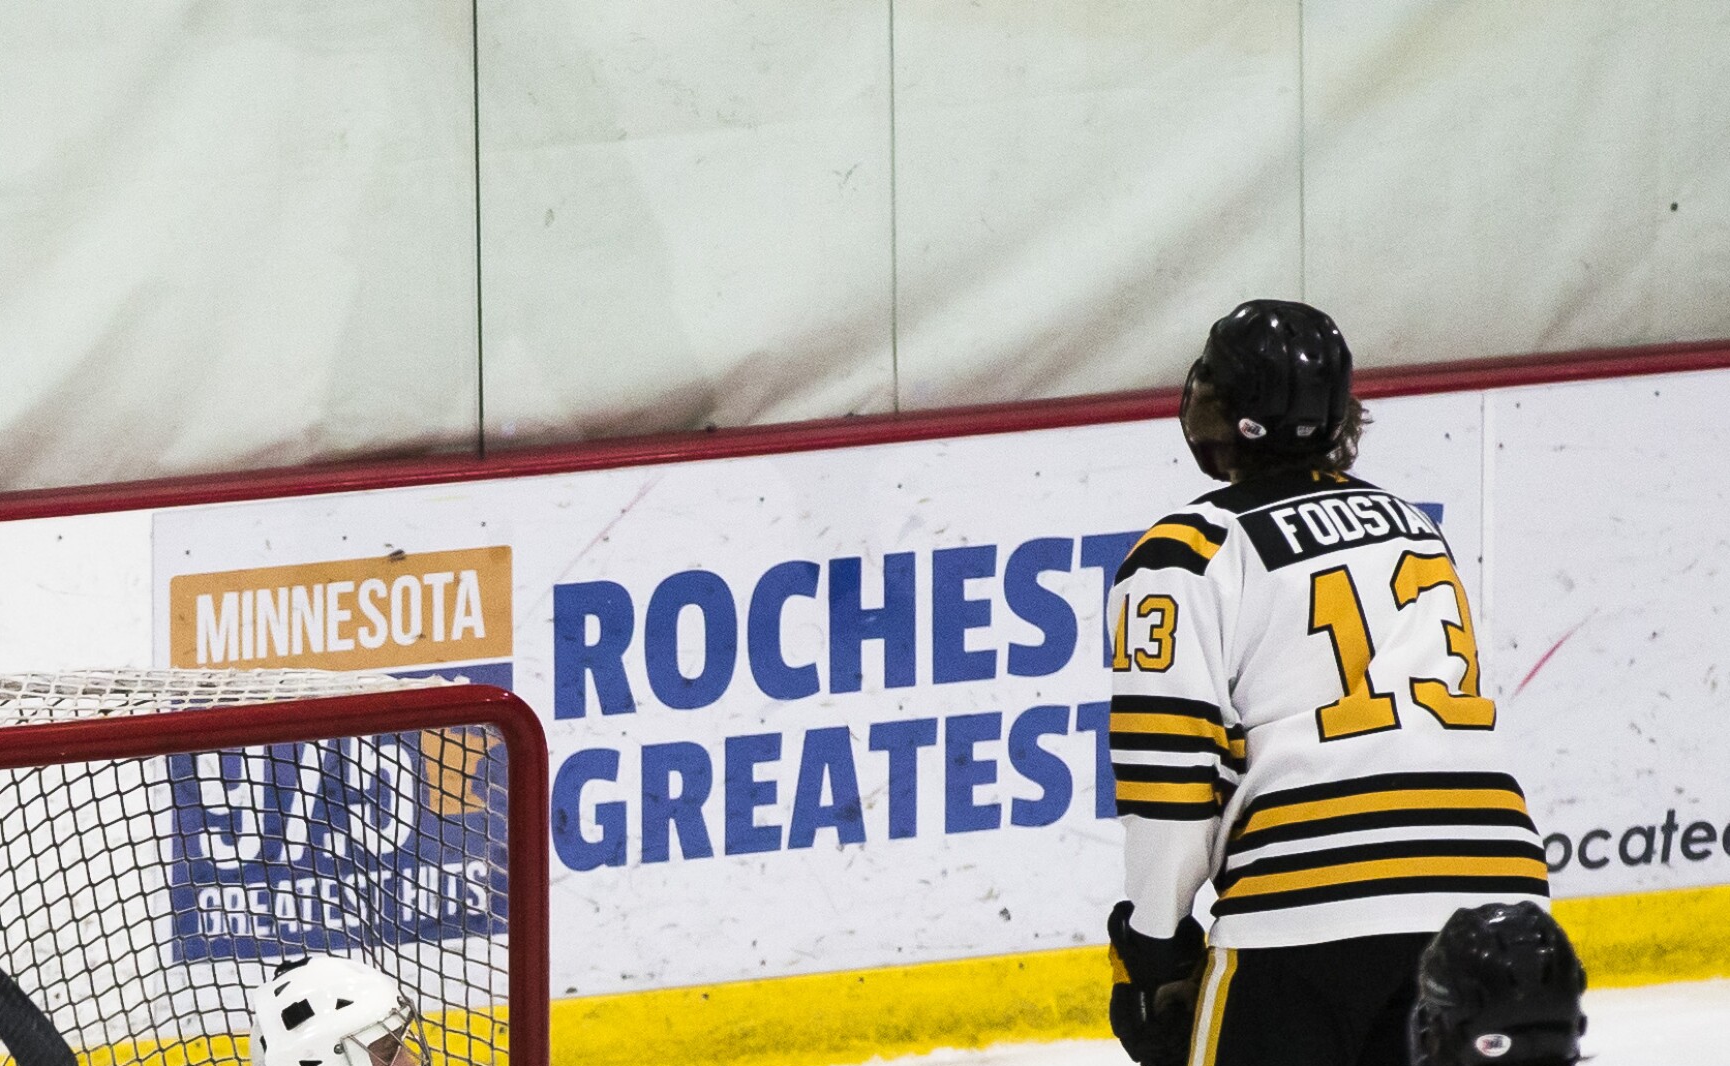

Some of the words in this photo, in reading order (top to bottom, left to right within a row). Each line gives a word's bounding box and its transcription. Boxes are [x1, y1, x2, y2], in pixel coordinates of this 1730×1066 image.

[195, 569, 487, 665] MINNESOTA
[1111, 593, 1178, 672] 13
[1308, 550, 1497, 743] 13
[550, 701, 1118, 872] GREATEST
[197, 870, 391, 937] GREATEST
[402, 860, 488, 924] HITS
